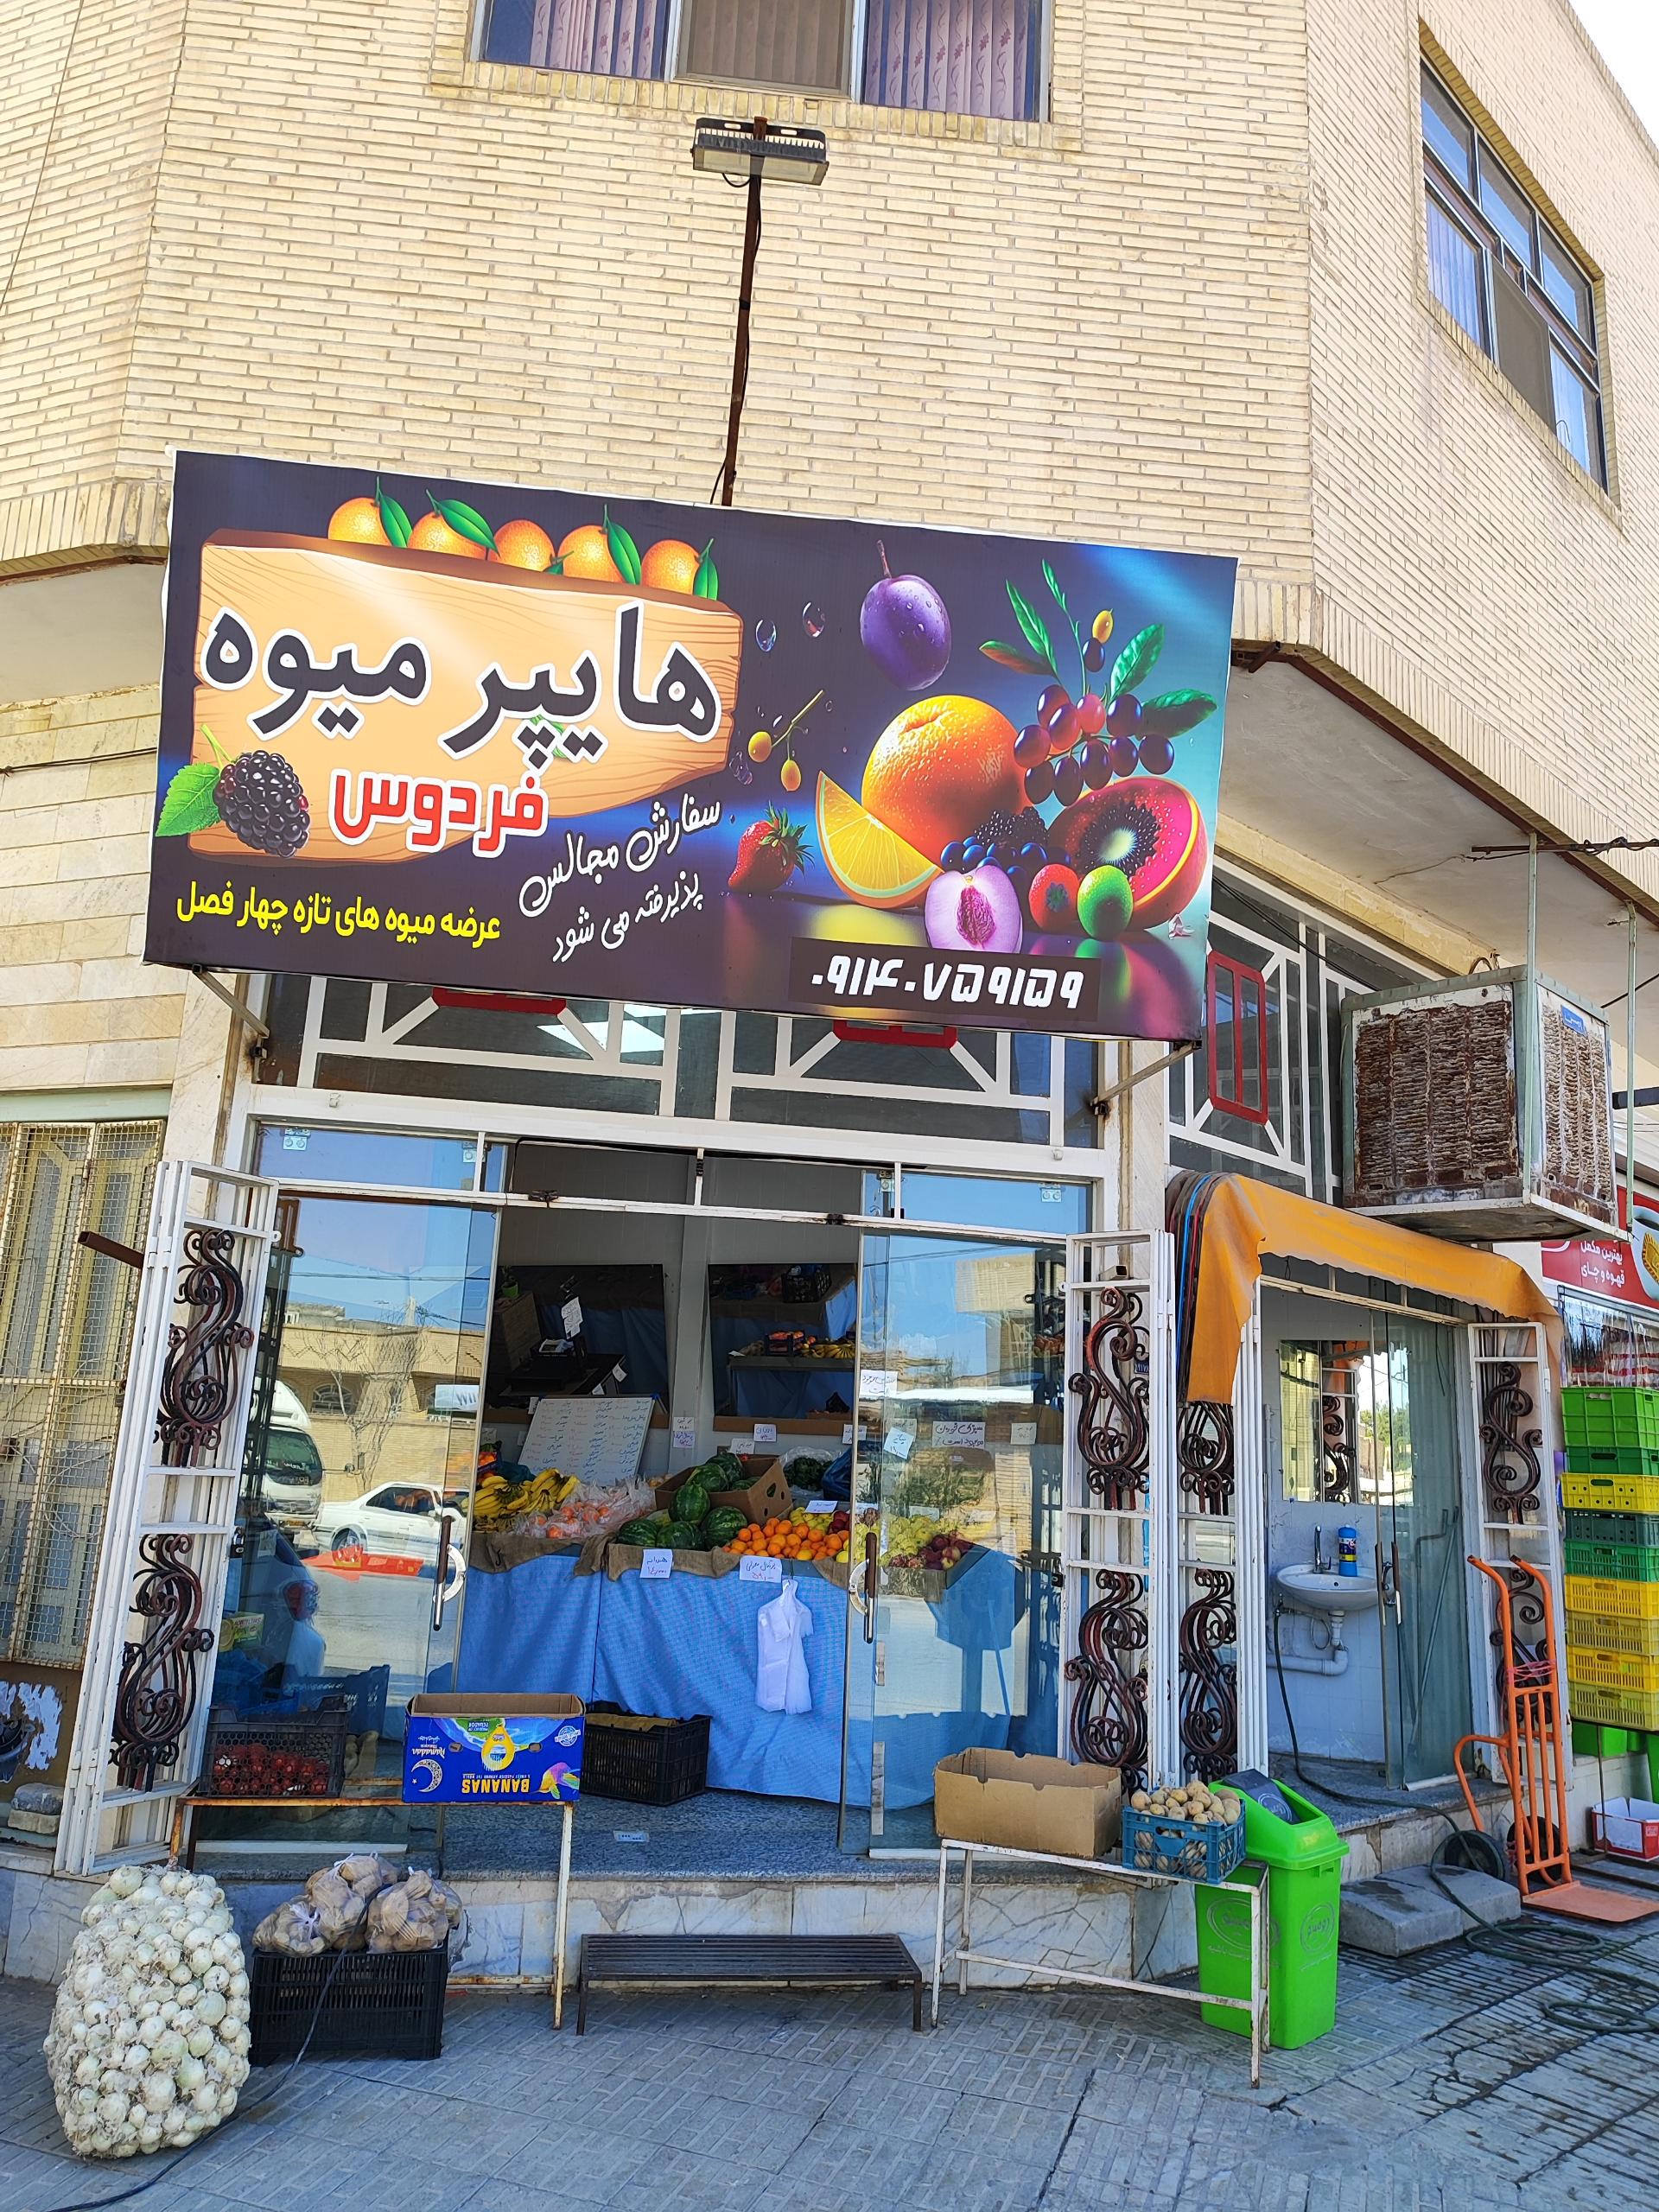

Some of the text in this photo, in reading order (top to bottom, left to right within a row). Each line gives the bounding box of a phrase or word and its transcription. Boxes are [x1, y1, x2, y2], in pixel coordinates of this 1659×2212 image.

[206, 605, 721, 769] هایپر میوه
[335, 775, 545, 852] فردوس
[518, 793, 721, 918] سفارش مجالس
[176, 880, 500, 948] عرضه میوه های تازه چهار فصل
[553, 871, 704, 962] پذیرفته می شود
[1605, 1269, 1625, 1287] قهوه
[942, 1437, 984, 1447] موجود است
[957, 1422, 983, 1435] سبزی
[411, 1746, 446, 1759] Ramadan
[461, 1778, 530, 1794] BANANAS
